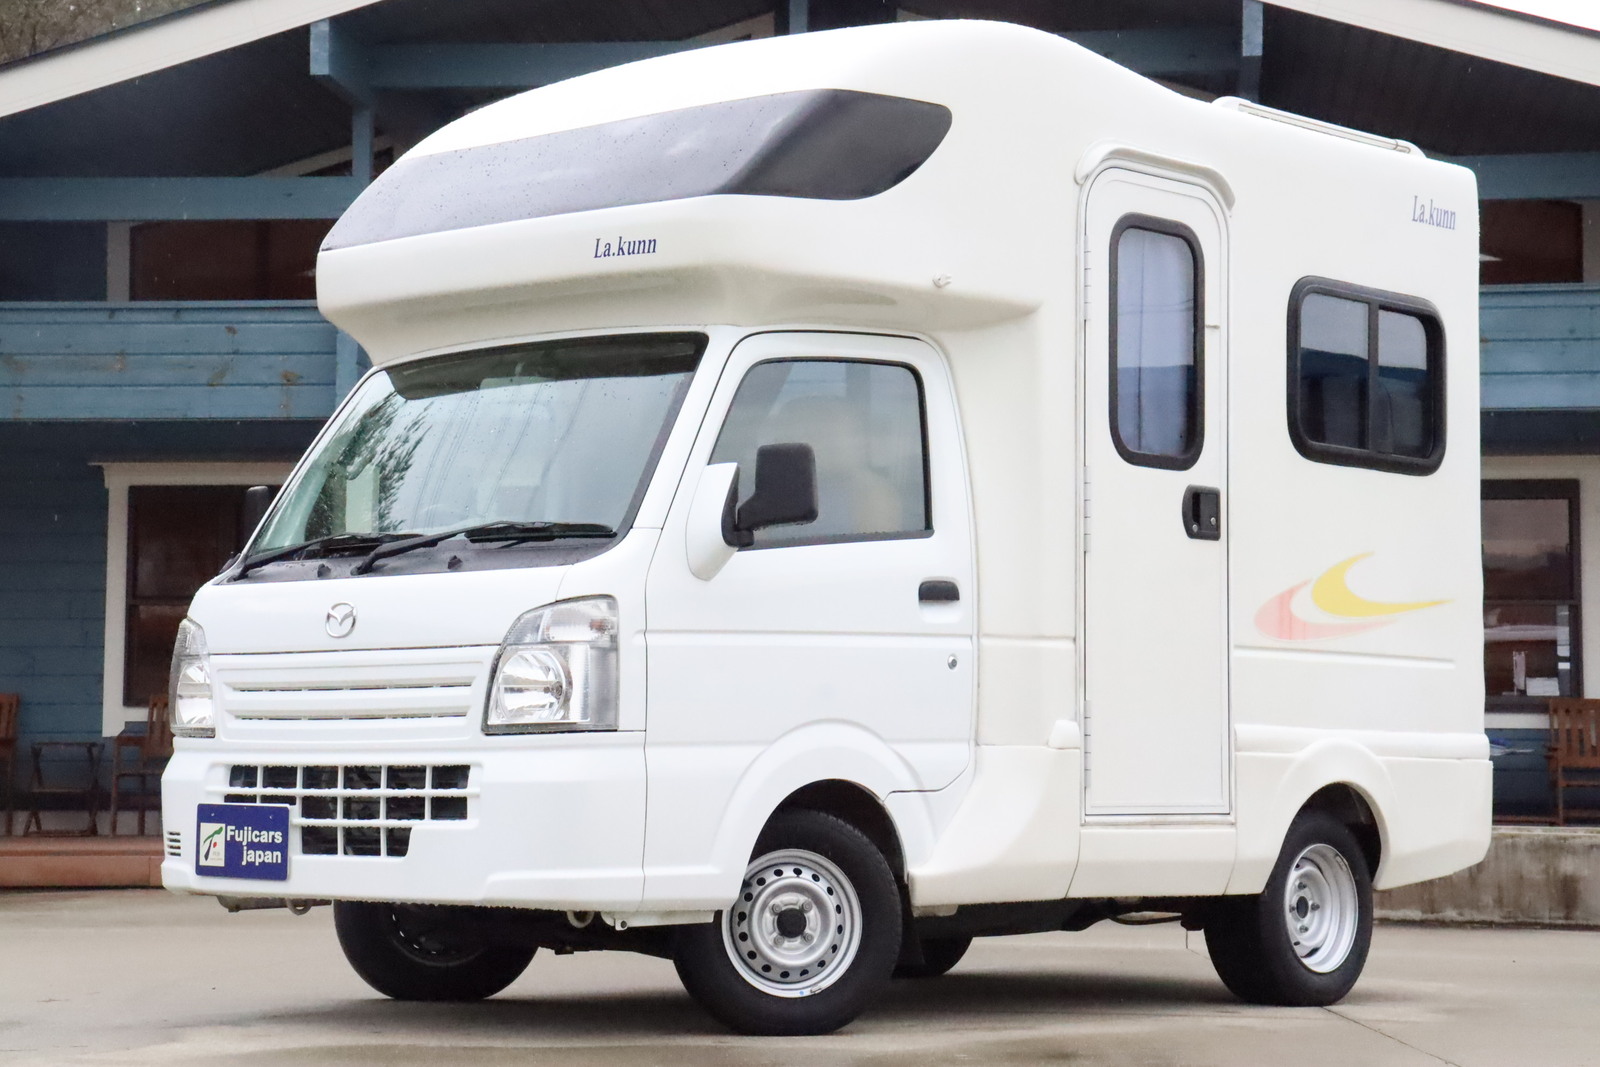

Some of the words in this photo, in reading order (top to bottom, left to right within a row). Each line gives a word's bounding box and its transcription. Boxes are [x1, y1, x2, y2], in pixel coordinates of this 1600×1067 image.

[1412, 195, 1456, 230] La.kunn
[594, 236, 657, 258] La.kunn
[226, 825, 283, 846] Fujicars
[242, 846, 282, 866] japan
